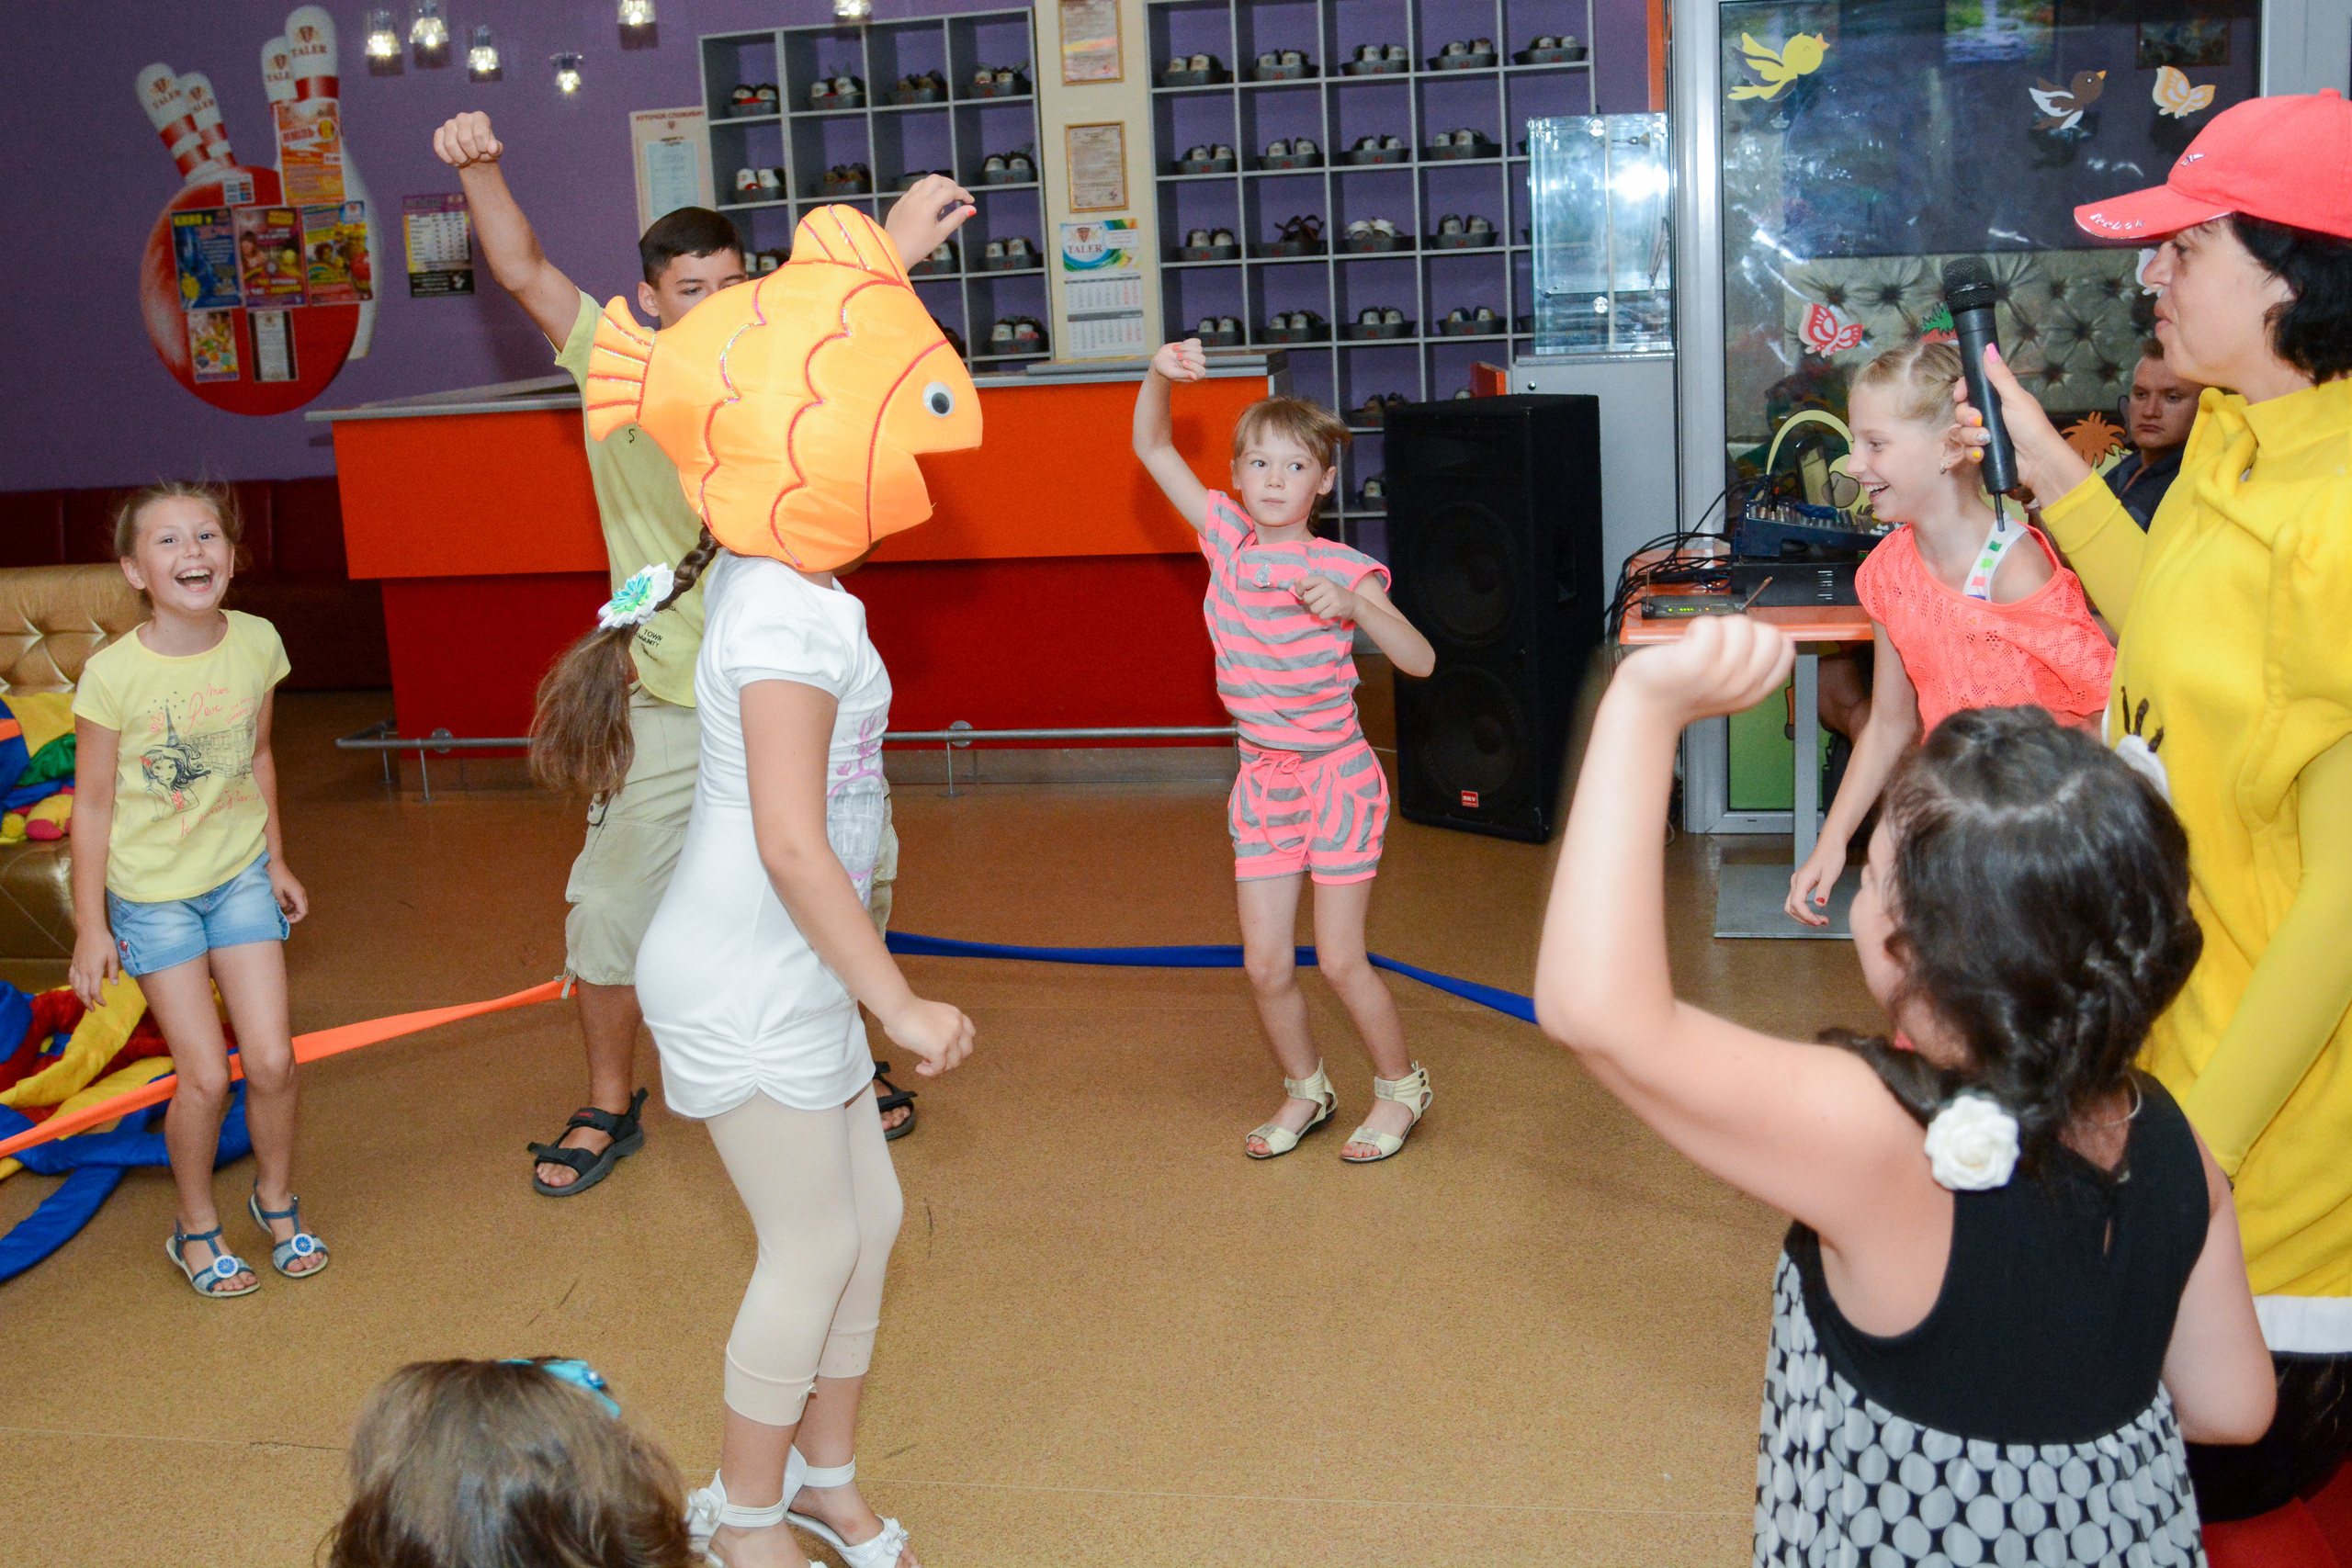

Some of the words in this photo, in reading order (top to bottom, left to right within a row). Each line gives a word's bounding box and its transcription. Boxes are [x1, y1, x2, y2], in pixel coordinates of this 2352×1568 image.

[290, 44, 327, 58] TALER
[266, 70, 293, 84] TALE
[192, 98, 215, 112] ALER
[2089, 213, 2145, 230] Reebok
[1067, 243, 1102, 254] TALER
[636, 632, 659, 648] OMMUNITY
[644, 628, 663, 641] TOWN
